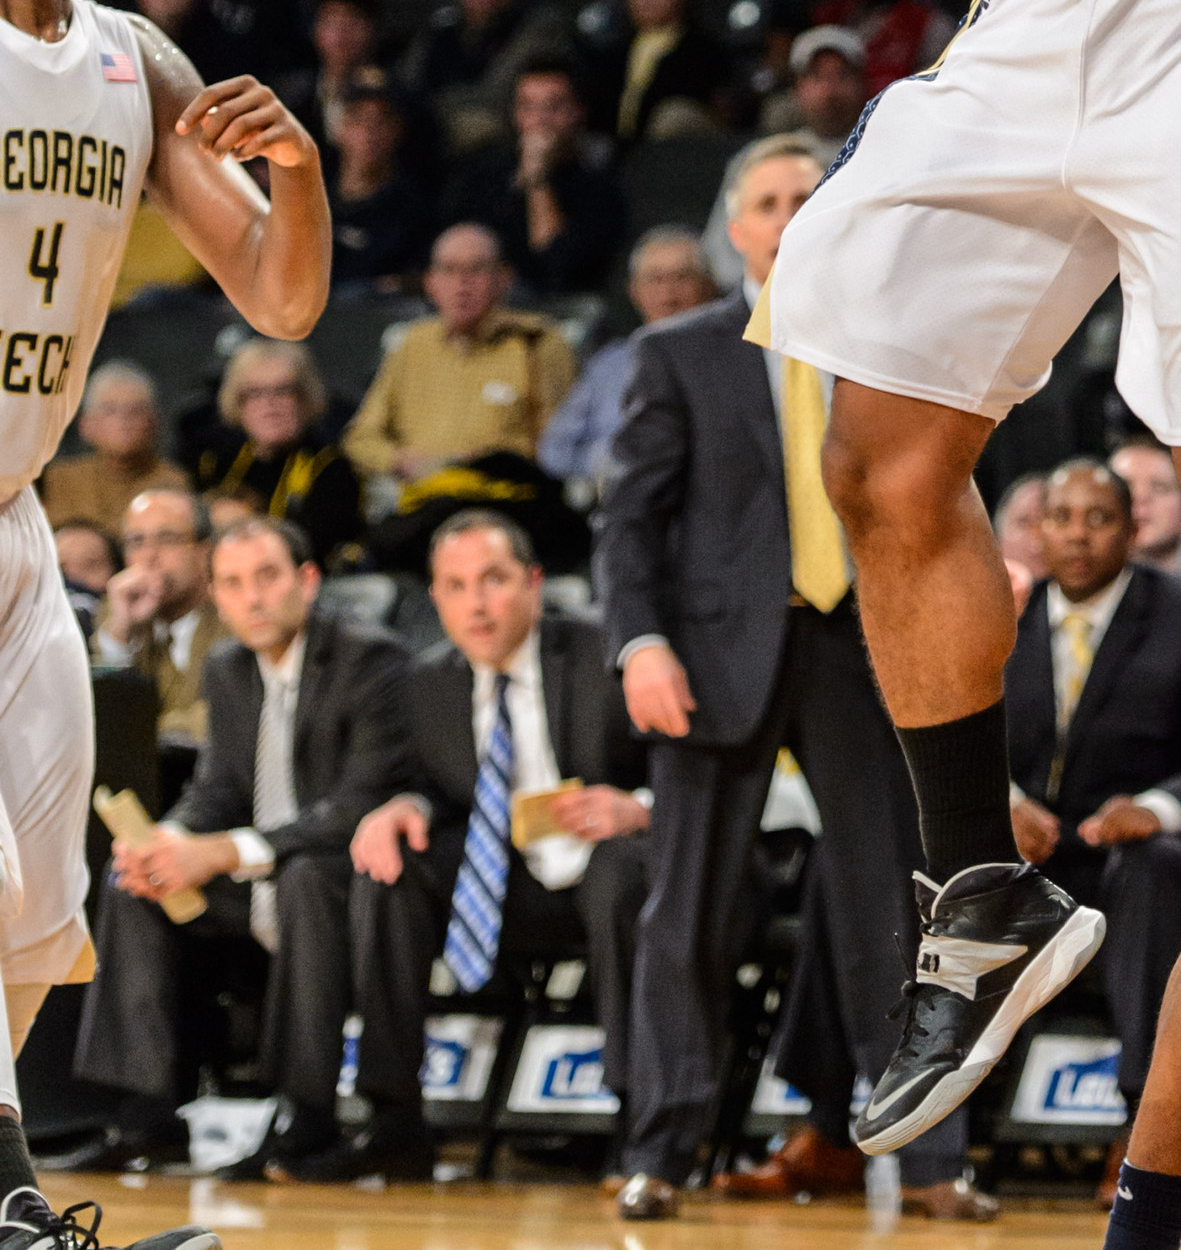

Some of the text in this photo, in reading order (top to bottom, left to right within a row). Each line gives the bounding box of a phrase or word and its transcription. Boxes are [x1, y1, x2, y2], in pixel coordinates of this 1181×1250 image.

[3, 128, 127, 210] EORGIA
[27, 222, 65, 307] 4
[0, 327, 74, 397] ECH
